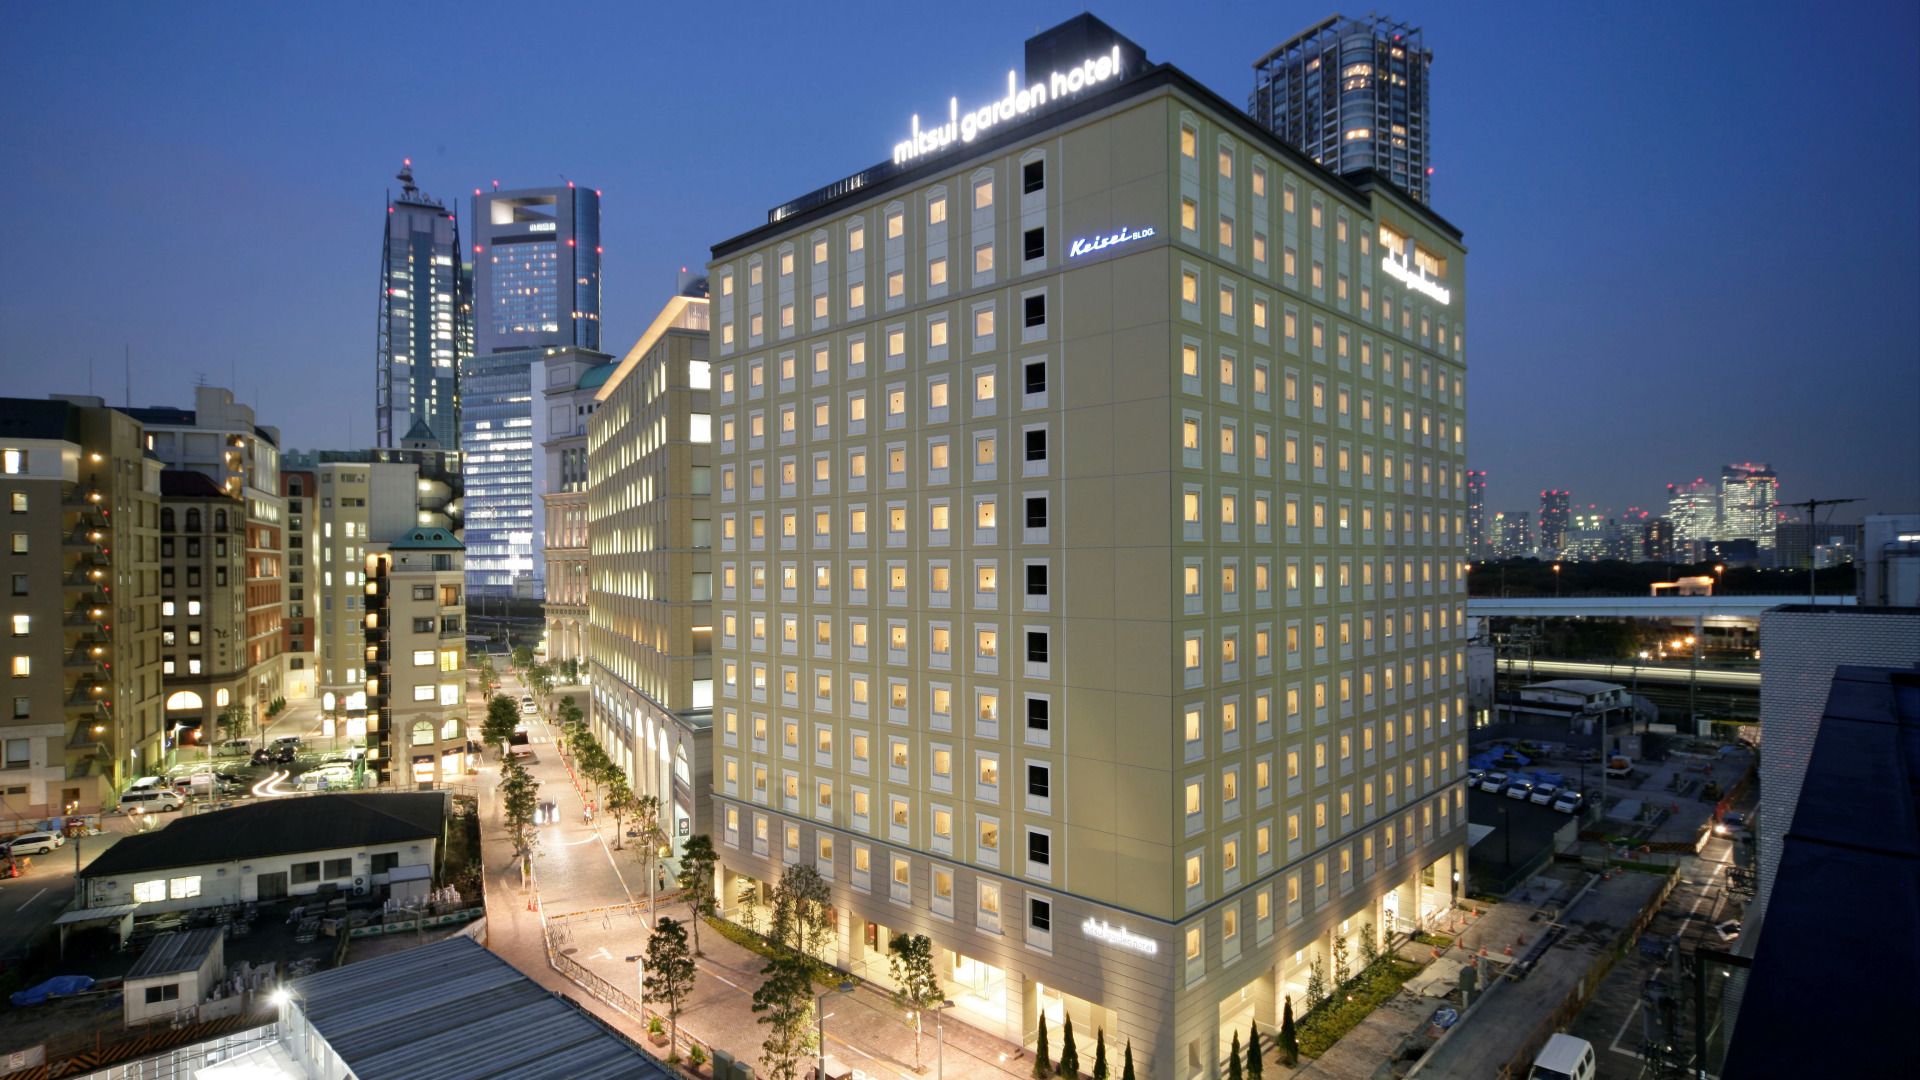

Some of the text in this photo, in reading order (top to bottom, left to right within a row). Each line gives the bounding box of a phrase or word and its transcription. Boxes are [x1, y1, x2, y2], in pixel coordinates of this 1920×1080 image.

[894, 45, 1120, 164] mitsui garden hotel
[1070, 227, 1132, 257] Keisei
